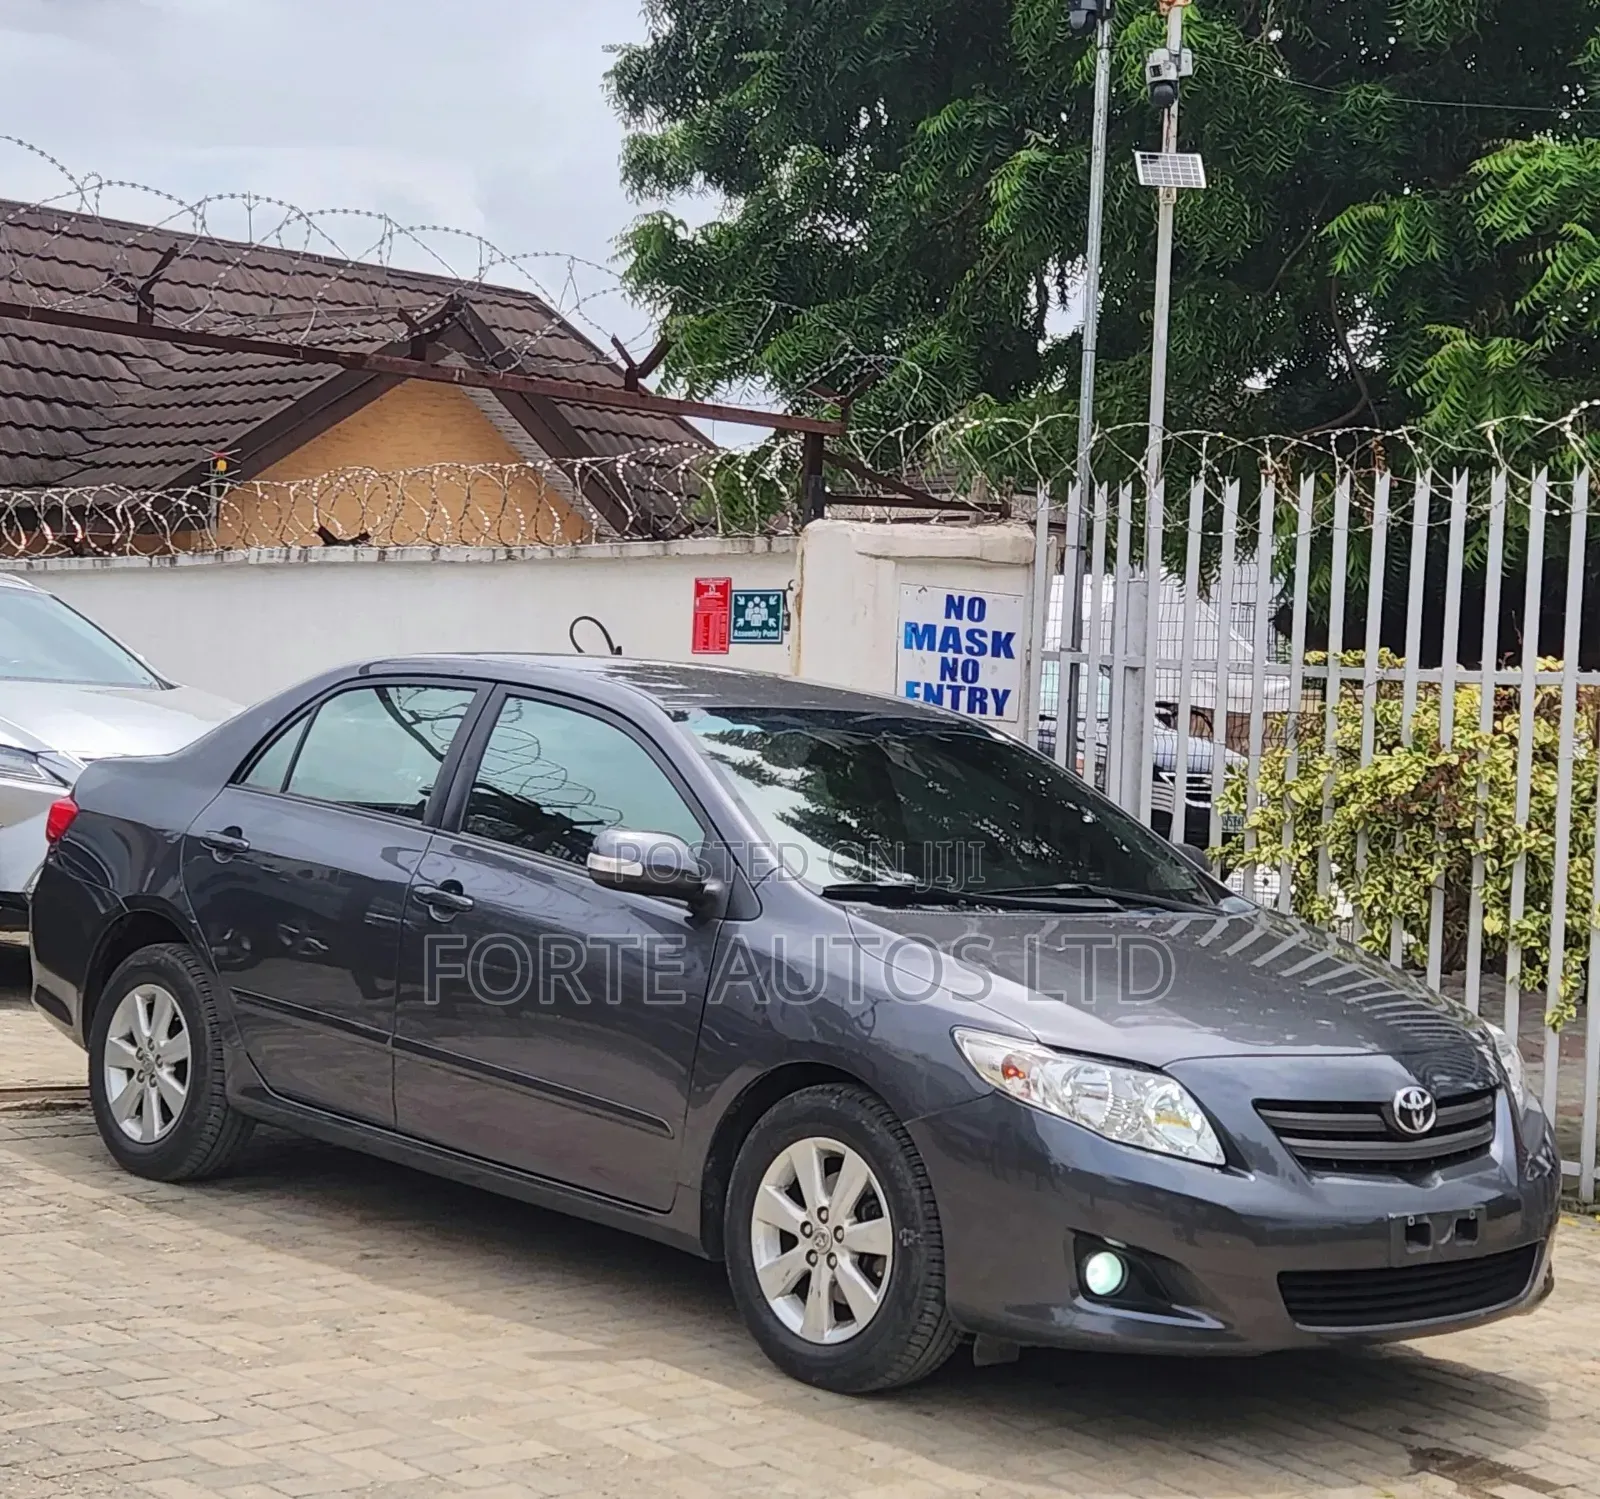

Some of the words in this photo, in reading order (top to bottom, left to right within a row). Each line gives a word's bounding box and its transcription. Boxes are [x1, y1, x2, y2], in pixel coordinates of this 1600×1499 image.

[944, 594, 987, 623] NO
[733, 629, 762, 639] Assembly
[762, 629, 779, 638] Point
[903, 621, 1016, 660] MASK
[940, 656, 980, 684] NO
[905, 680, 1012, 717] ENTRY
